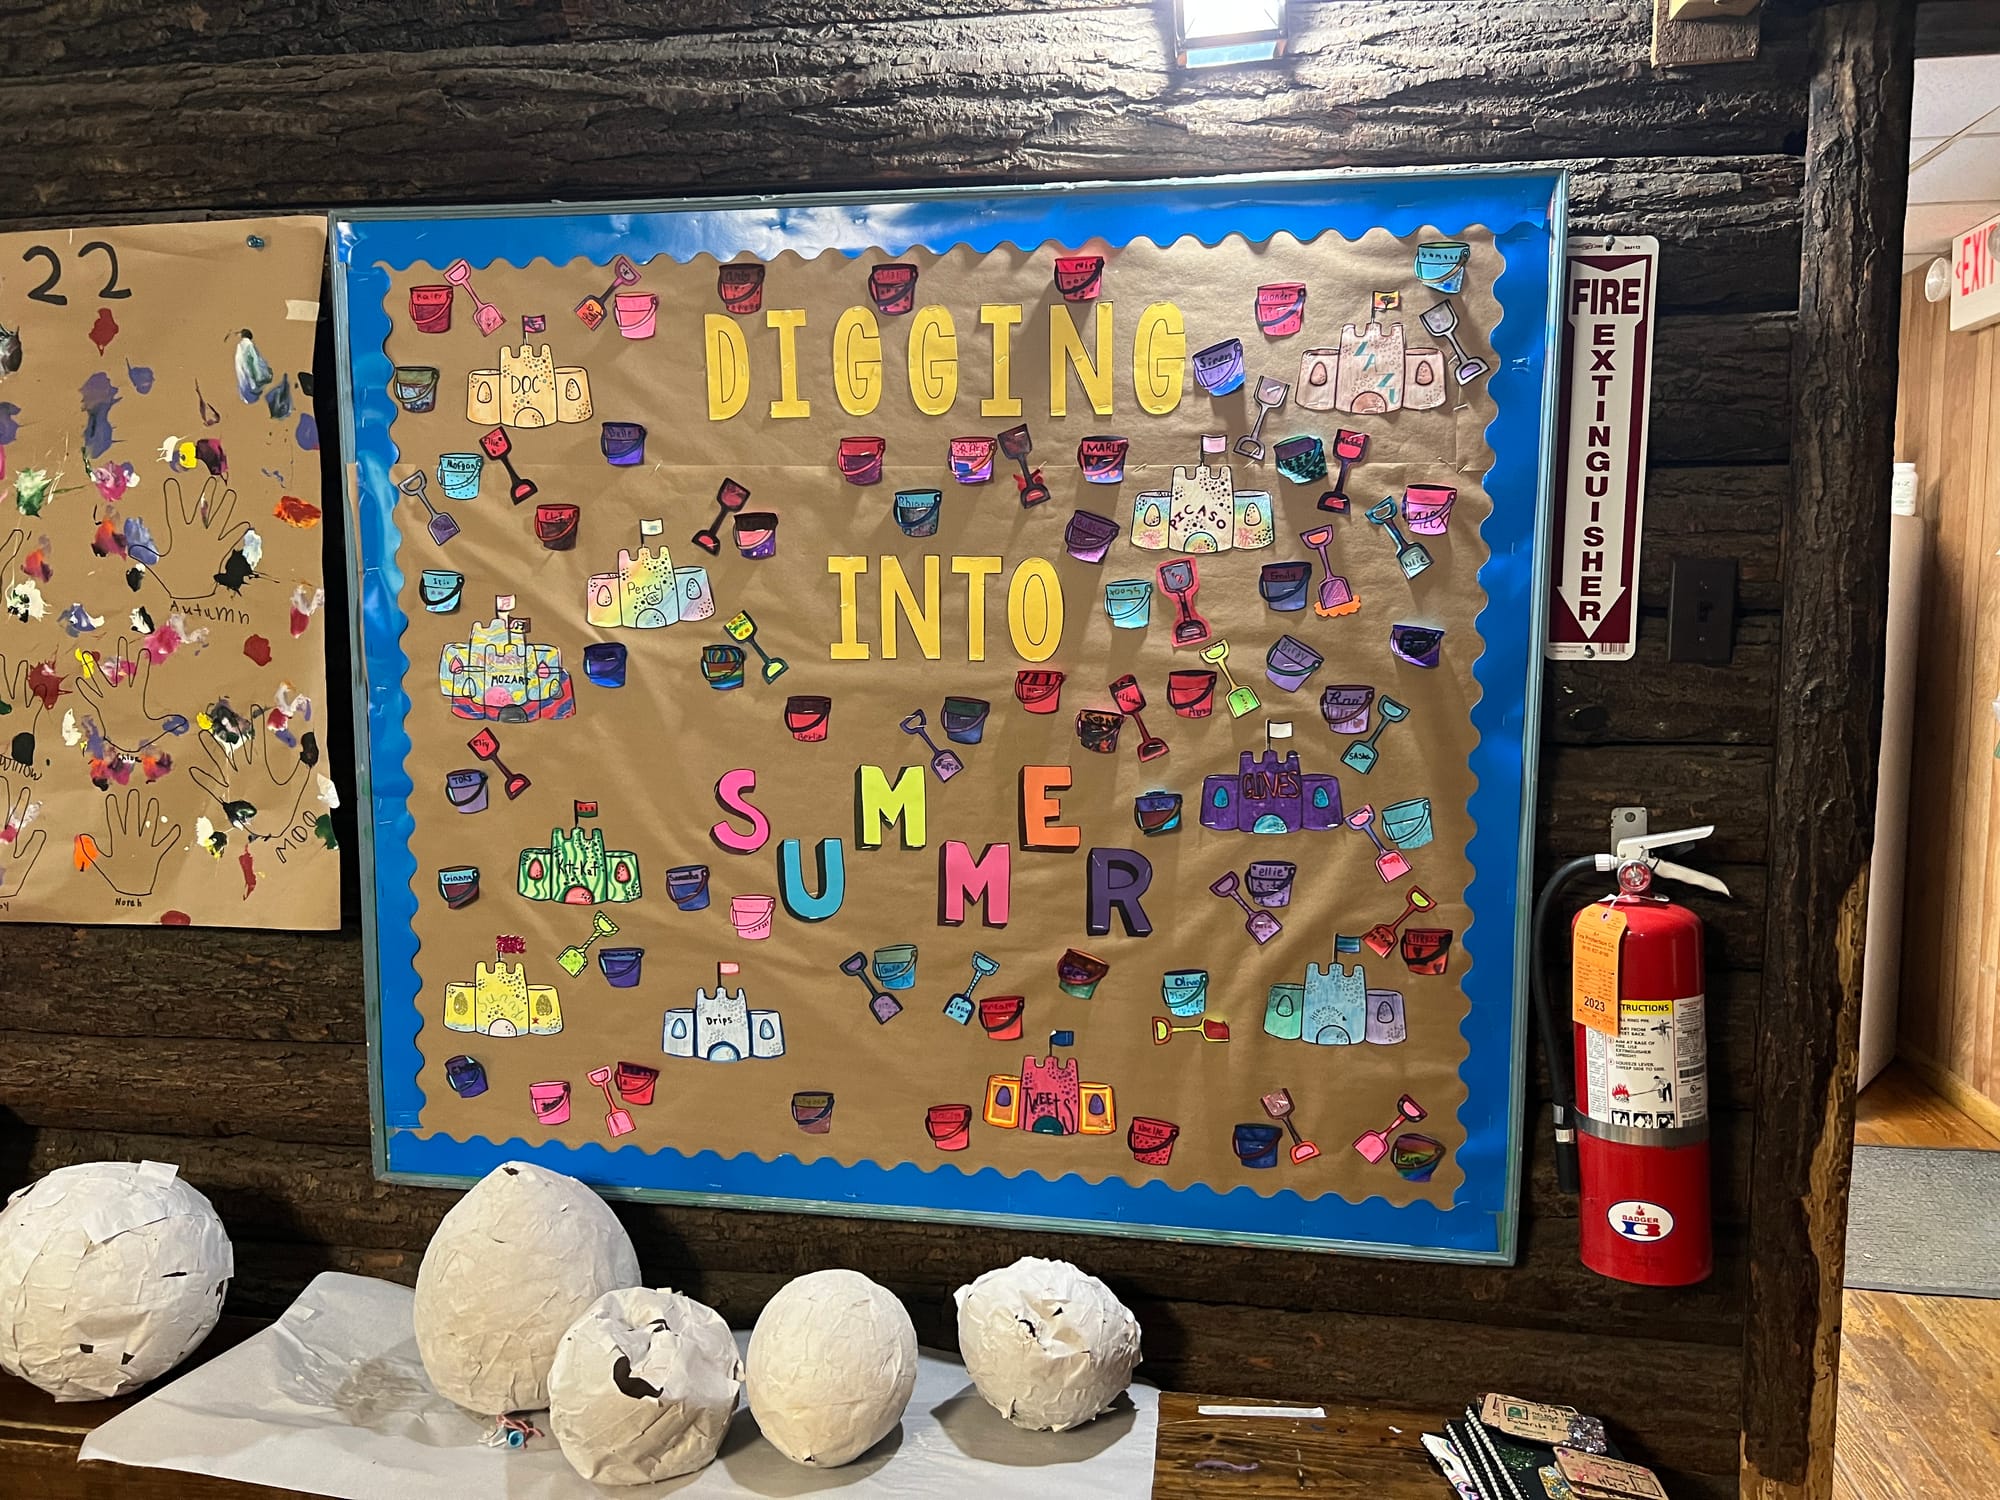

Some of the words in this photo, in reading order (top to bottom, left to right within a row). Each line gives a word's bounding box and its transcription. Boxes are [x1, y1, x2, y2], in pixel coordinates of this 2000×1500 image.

[1571, 279, 1641, 315] FIRE
[704, 301, 1186, 421] DIGGING
[510, 374, 540, 394] DOC
[1579, 323, 1616, 622] EXTINGUISHER
[827, 555, 1064, 662] INTO
[491, 674, 531, 686] MOZART
[709, 764, 1153, 938] SUMMER
[1584, 996, 1605, 1012] 2023
[1620, 1004, 1669, 1012] TRUCTIONS
[706, 1014, 733, 1026] Drips
[1622, 1214, 1659, 1223] BADGER
